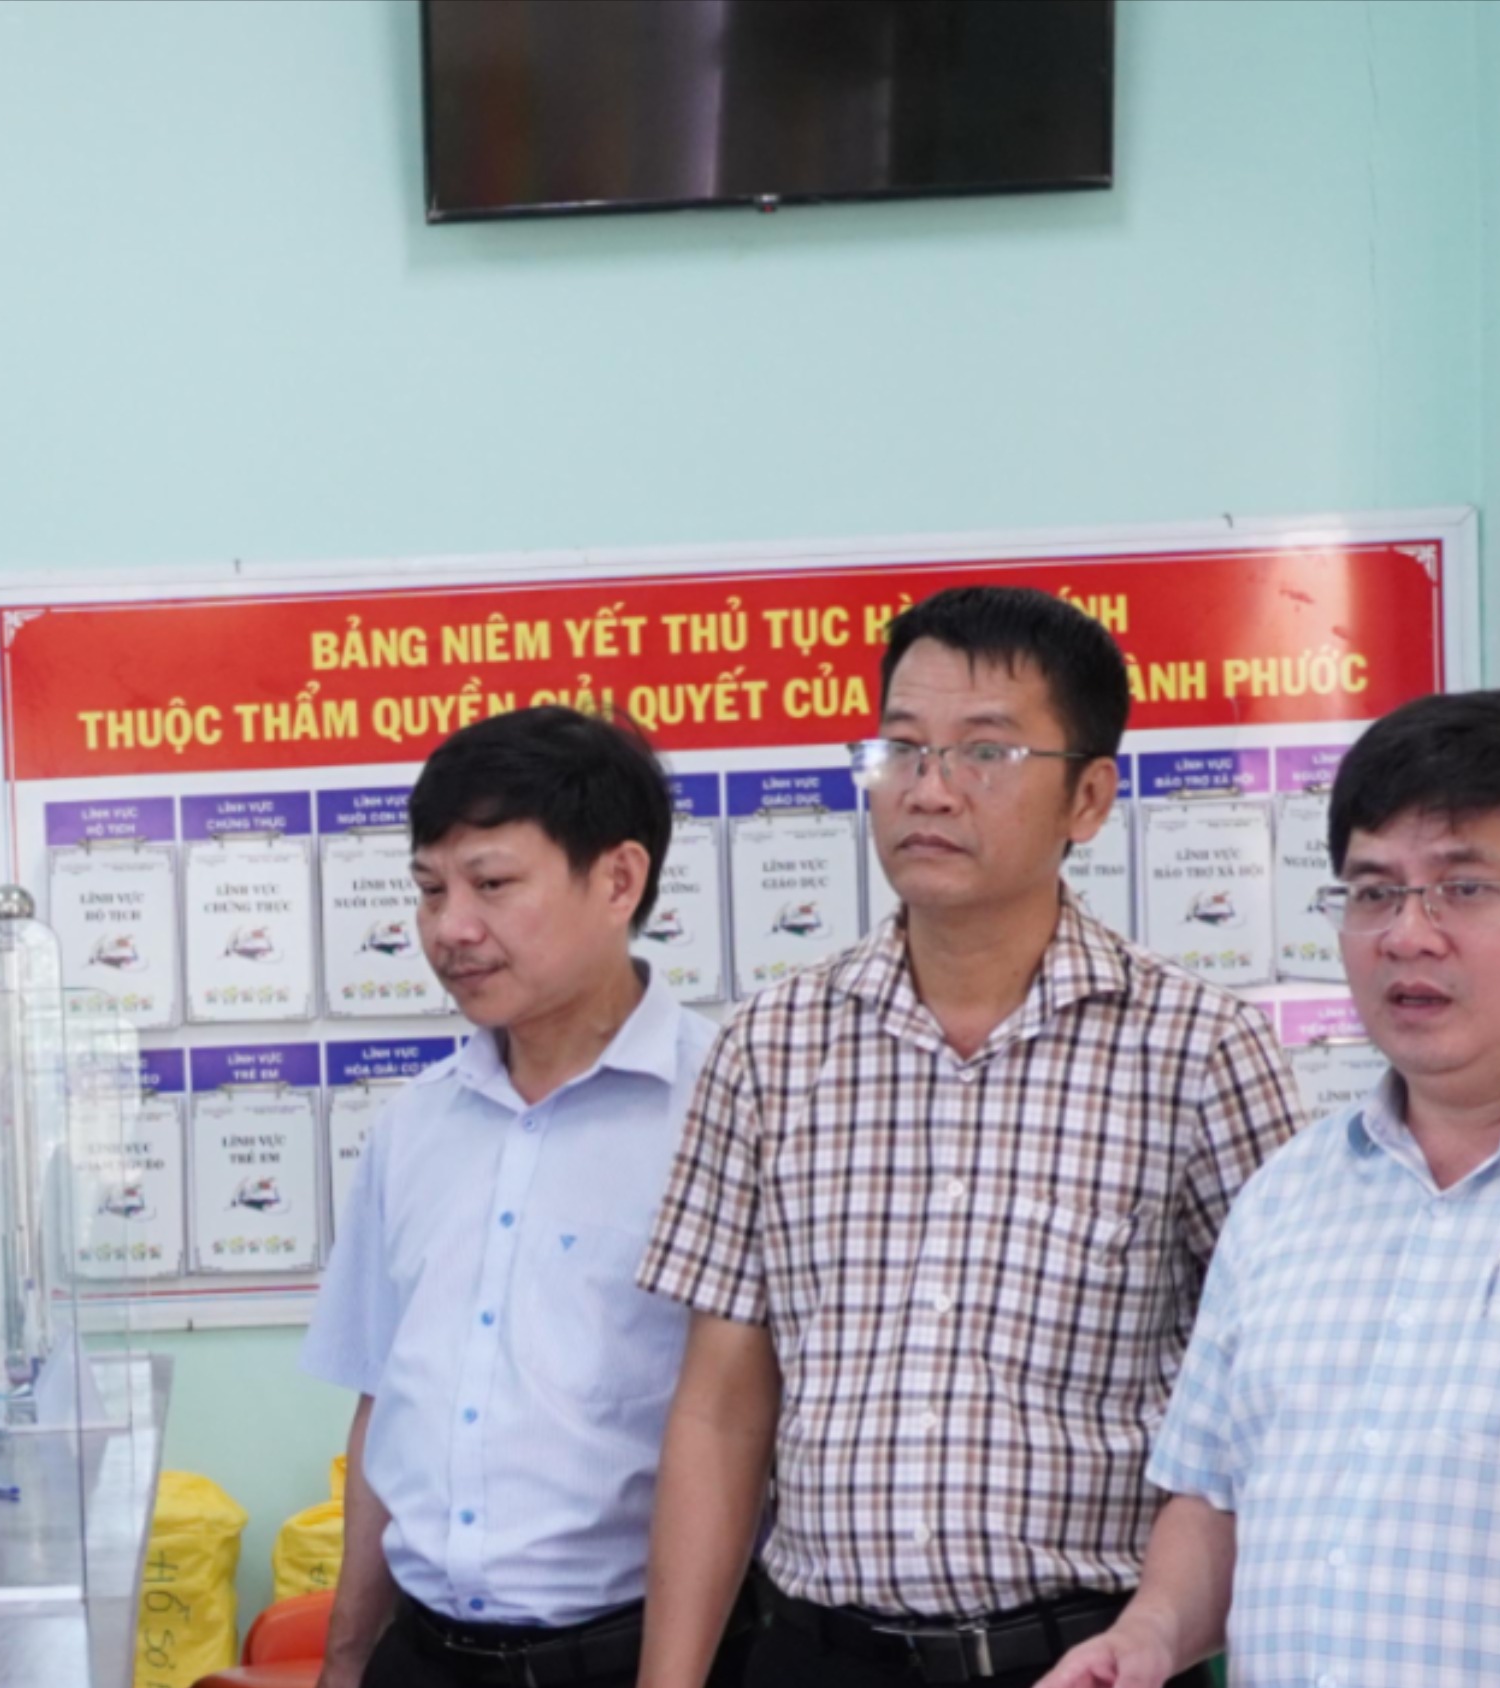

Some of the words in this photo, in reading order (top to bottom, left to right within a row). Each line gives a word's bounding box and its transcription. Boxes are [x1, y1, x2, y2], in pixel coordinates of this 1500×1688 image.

[310, 615, 428, 671] BẢNG
[441, 612, 551, 664] NIÊM
[563, 602, 647, 657] YẾT
[659, 596, 748, 654] THỦ
[762, 605, 850, 655] TỤC
[78, 697, 222, 753] THUỘC
[234, 681, 358, 742] THẨM
[371, 676, 515, 742] QUYỀN
[628, 666, 767, 732] QUYẾT
[782, 661, 870, 718] CỦA
[1223, 649, 1369, 697] PHƯỚC
